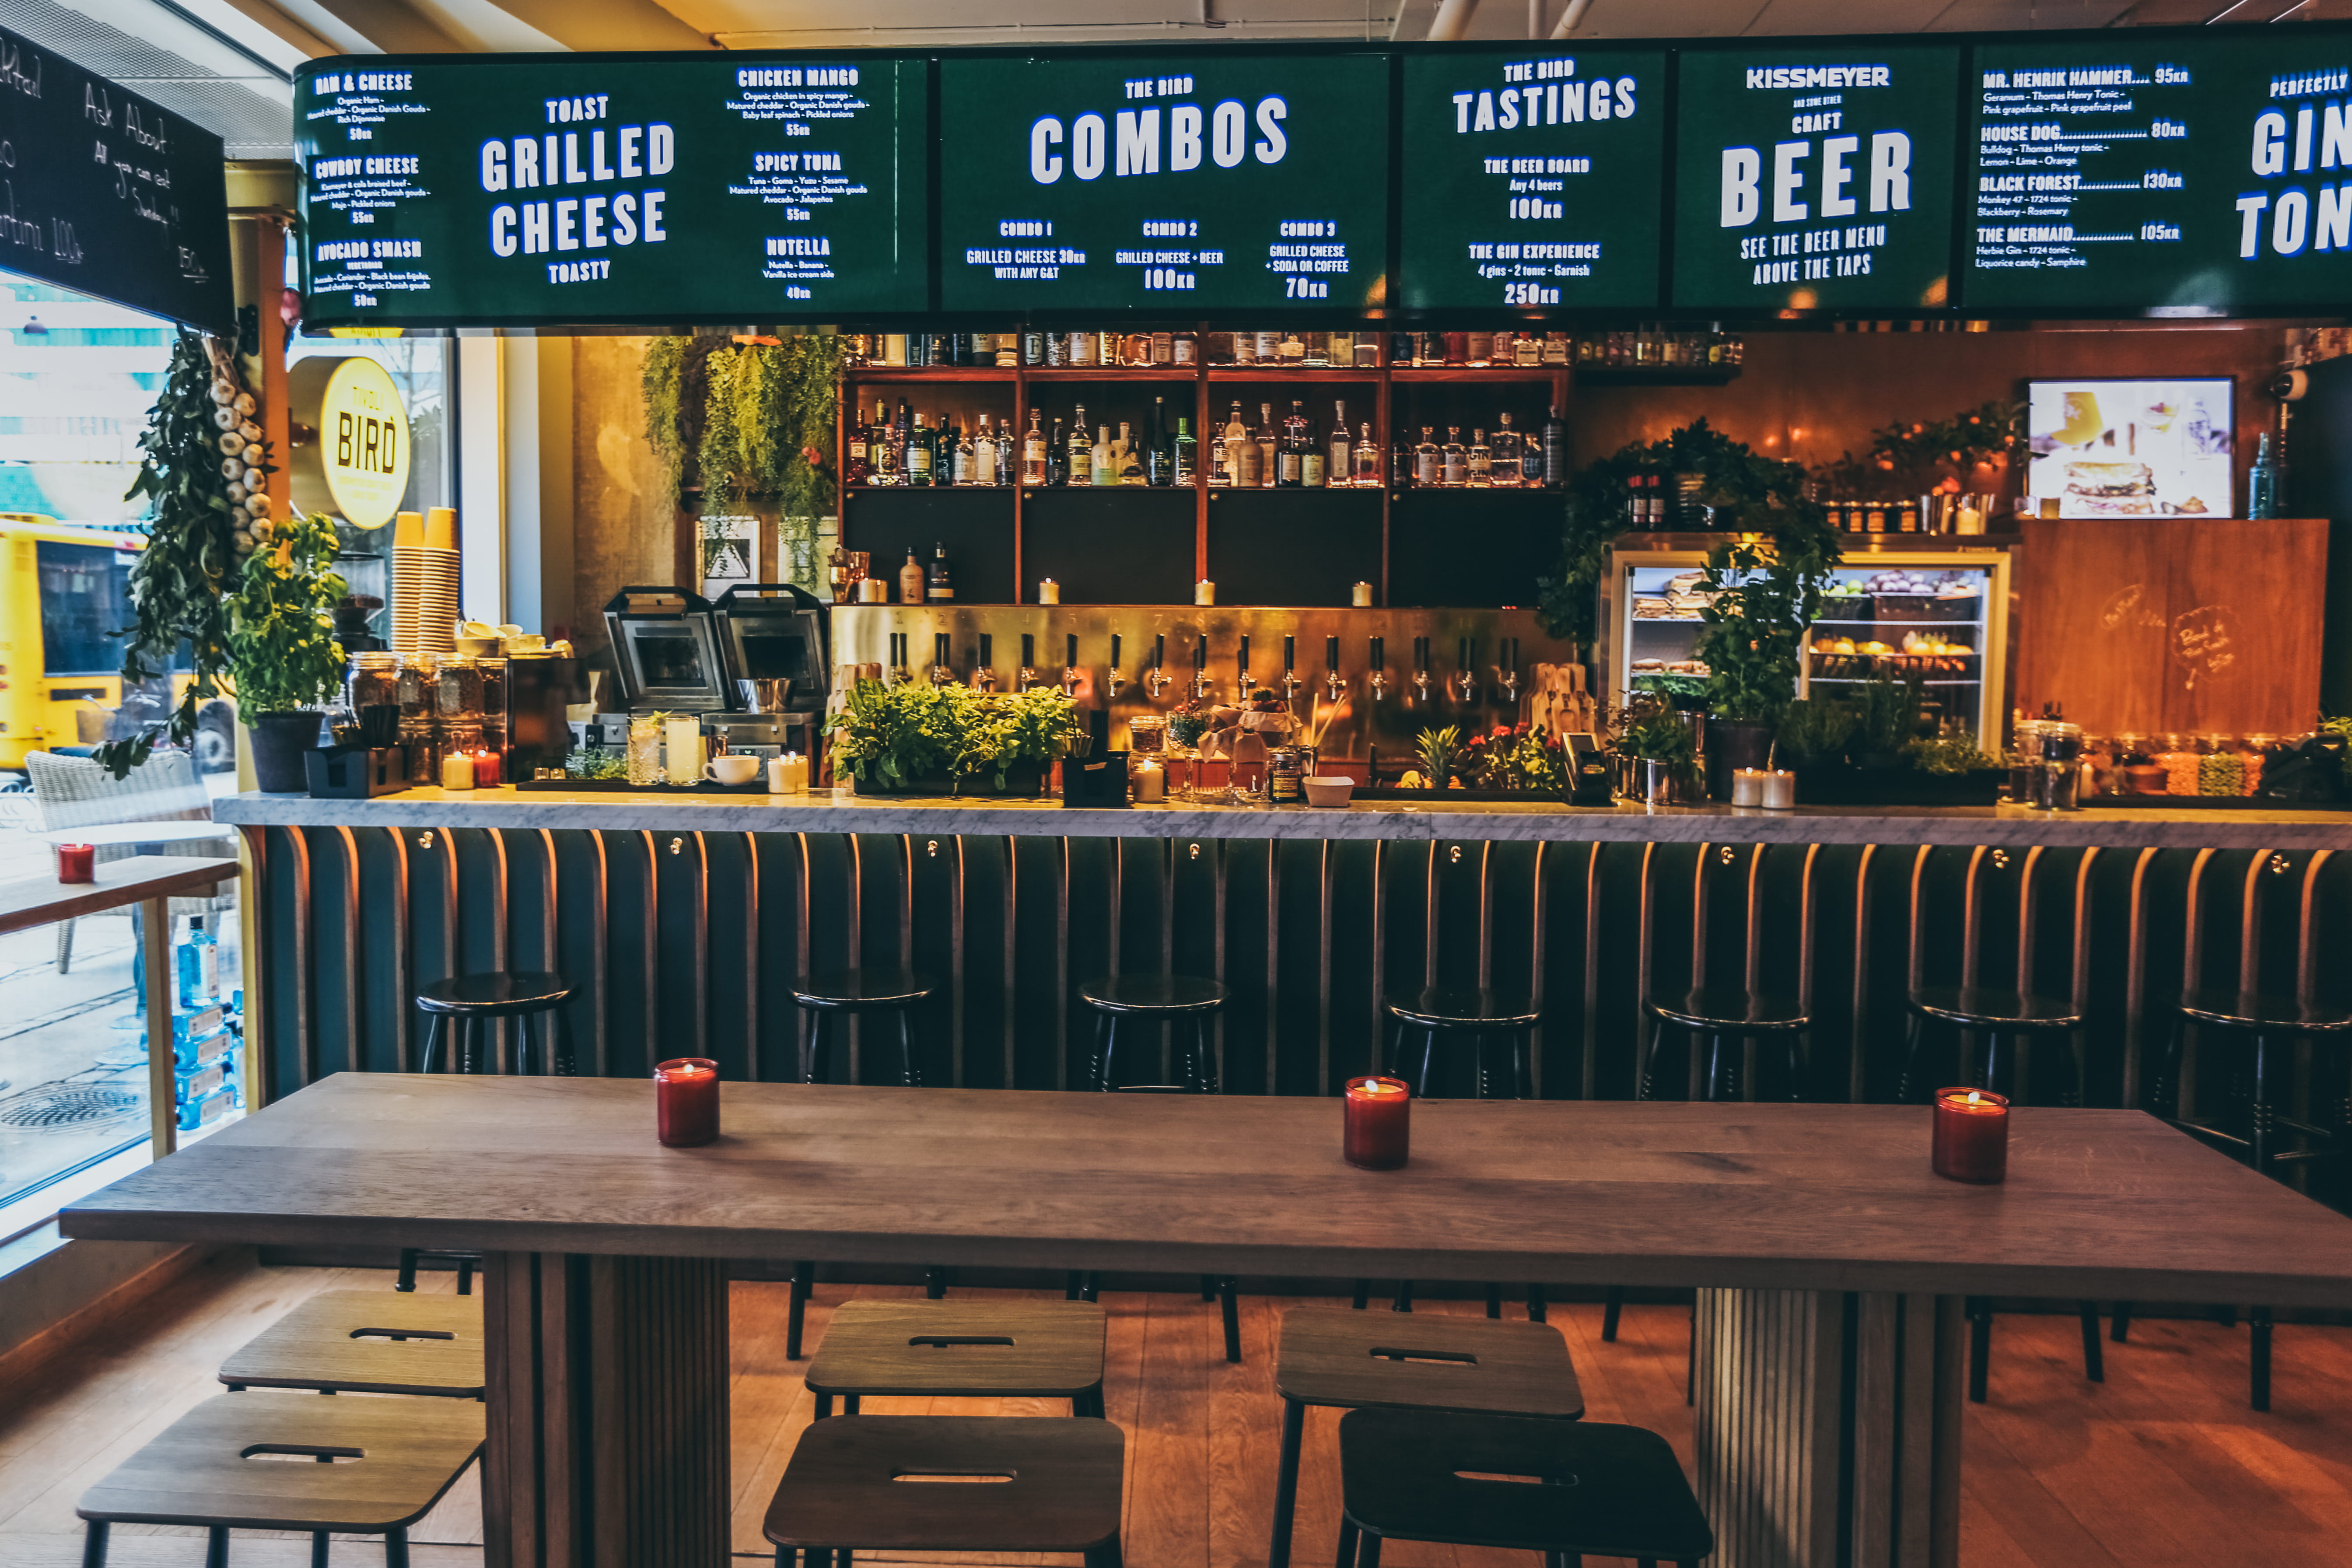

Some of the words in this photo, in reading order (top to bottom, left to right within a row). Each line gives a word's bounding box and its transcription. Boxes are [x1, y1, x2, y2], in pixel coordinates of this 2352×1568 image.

[739, 70, 802, 87] CHICKEN
[807, 69, 858, 86] MANGO
[1504, 63, 1532, 82] THE
[1538, 60, 1574, 79] BIRD
[1747, 67, 1889, 88] KISSMEYER
[1983, 74, 2009, 88] MR.
[2013, 72, 2066, 88] HENRIK
[2155, 68, 2188, 83] 95KR
[316, 76, 340, 95] HAM
[344, 75, 354, 91] &
[359, 74, 412, 91] CHEESE
[1125, 81, 1152, 98] THE
[1158, 77, 1192, 95] BIRD
[2270, 74, 2348, 97] PERFECTLY
[85, 81, 113, 129] Ask
[744, 92, 771, 102] Organic
[807, 93, 824, 102] spicy
[790, 102, 817, 111] Organic
[844, 102, 865, 110] gouda
[1453, 78, 1635, 133] TASTINGS
[546, 96, 608, 123] TOAST
[743, 112, 760, 120] Baby
[775, 111, 800, 119] spinach
[787, 124, 809, 136] 55KR
[1792, 112, 1841, 133] CRAFT
[1981, 126, 2028, 141] HOUSE
[2152, 122, 2184, 137] 80KR
[1032, 98, 1286, 183] COMBOS
[2252, 104, 2352, 175] GIN
[483, 125, 673, 192] GRILLED
[756, 155, 798, 171] SPICY
[803, 154, 841, 171] TUNA
[1484, 160, 1508, 173] THE
[1512, 159, 1544, 173] BEER
[1548, 159, 1589, 173] BOARD
[316, 159, 362, 179] COWBOY
[366, 158, 418, 174] CHEESE
[1509, 179, 1527, 192] Any
[1529, 179, 1535, 190] 4
[1537, 179, 1562, 190] beers
[1721, 133, 1909, 227] BEER
[1980, 177, 2024, 191] BLACK
[2144, 173, 2181, 188] 130KR
[792, 186, 820, 195] Organic
[846, 186, 868, 195] gouda
[787, 209, 810, 220] 55KR
[1510, 199, 1561, 219] 100KR
[493, 192, 666, 256] CHEESE
[1001, 222, 1042, 236] COMBO
[1047, 223, 1051, 235] 1
[1144, 223, 1186, 236] COMBO
[1190, 223, 1197, 236] 2
[1281, 223, 1323, 236] COMBO
[1327, 223, 1335, 236] 3
[2236, 186, 2352, 257] TON
[1741, 237, 1766, 259] SEE
[1772, 234, 1798, 256] THE
[1805, 230, 1839, 252] BEER
[1846, 226, 1884, 248] MENU
[1977, 228, 2004, 242] THE
[2141, 225, 2179, 239] 105KR
[318, 242, 368, 261] AVOCADO
[373, 241, 421, 257] SMASH
[767, 239, 830, 256] NUTELLA
[967, 251, 1011, 263] GRILLED
[1015, 251, 1056, 263] CHEESE
[1060, 250, 1085, 263] 30KR
[1270, 245, 1307, 256] GRILLED
[1310, 246, 1345, 257] CHEESE
[1469, 245, 1492, 259] THE
[1497, 245, 1519, 259] GIN
[1523, 245, 1600, 259] EXPERIENCE
[1116, 252, 1153, 263] GRILLED
[1156, 252, 1190, 263] CHEESE
[1200, 252, 1223, 263] BEER
[1273, 261, 1298, 271] SODA
[1300, 261, 1312, 271] OR
[1315, 261, 1348, 272] COFFEE
[549, 261, 610, 284] TOASTY
[995, 268, 1018, 278] WITH
[1020, 268, 1038, 278] ANY
[1040, 267, 1059, 278] G&T
[1145, 269, 1194, 288] 100KR
[1478, 265, 1484, 276] 4
[1487, 266, 1506, 278] gins
[1514, 264, 1521, 276] 2
[1523, 266, 1546, 276] tonic
[1555, 265, 1589, 276] Garnish
[1754, 261, 1798, 285] ABOVE
[1804, 258, 1830, 279] THE
[1836, 254, 1870, 276] TAPS
[787, 287, 810, 298] 40KR
[1287, 278, 1327, 298] 70KR
[1505, 284, 1558, 304] 250KR
